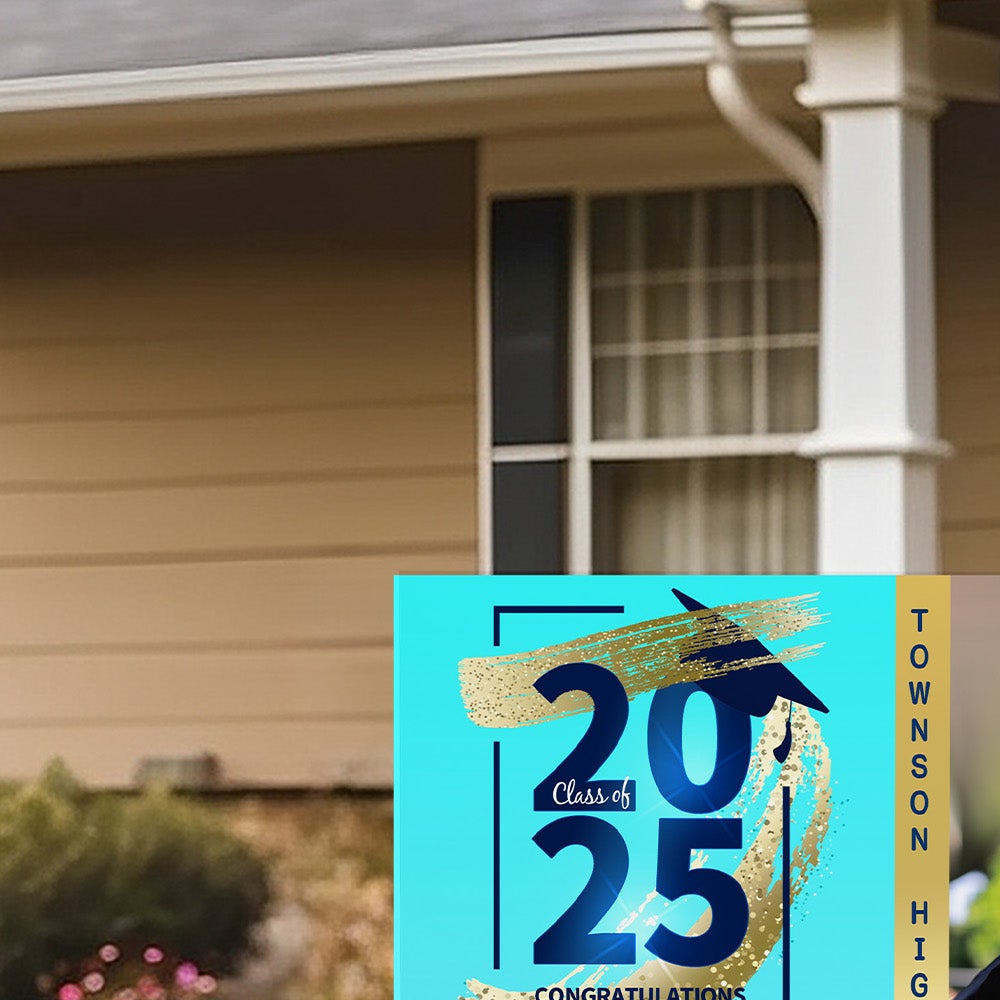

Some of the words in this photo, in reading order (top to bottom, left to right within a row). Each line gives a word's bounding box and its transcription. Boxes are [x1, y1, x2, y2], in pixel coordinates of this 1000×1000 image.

[532, 662, 752, 814] 20
[552, 780, 609, 806] Class
[611, 776, 631, 810] of
[909, 608, 931, 852] TOWNSON
[531, 815, 750, 967] 25
